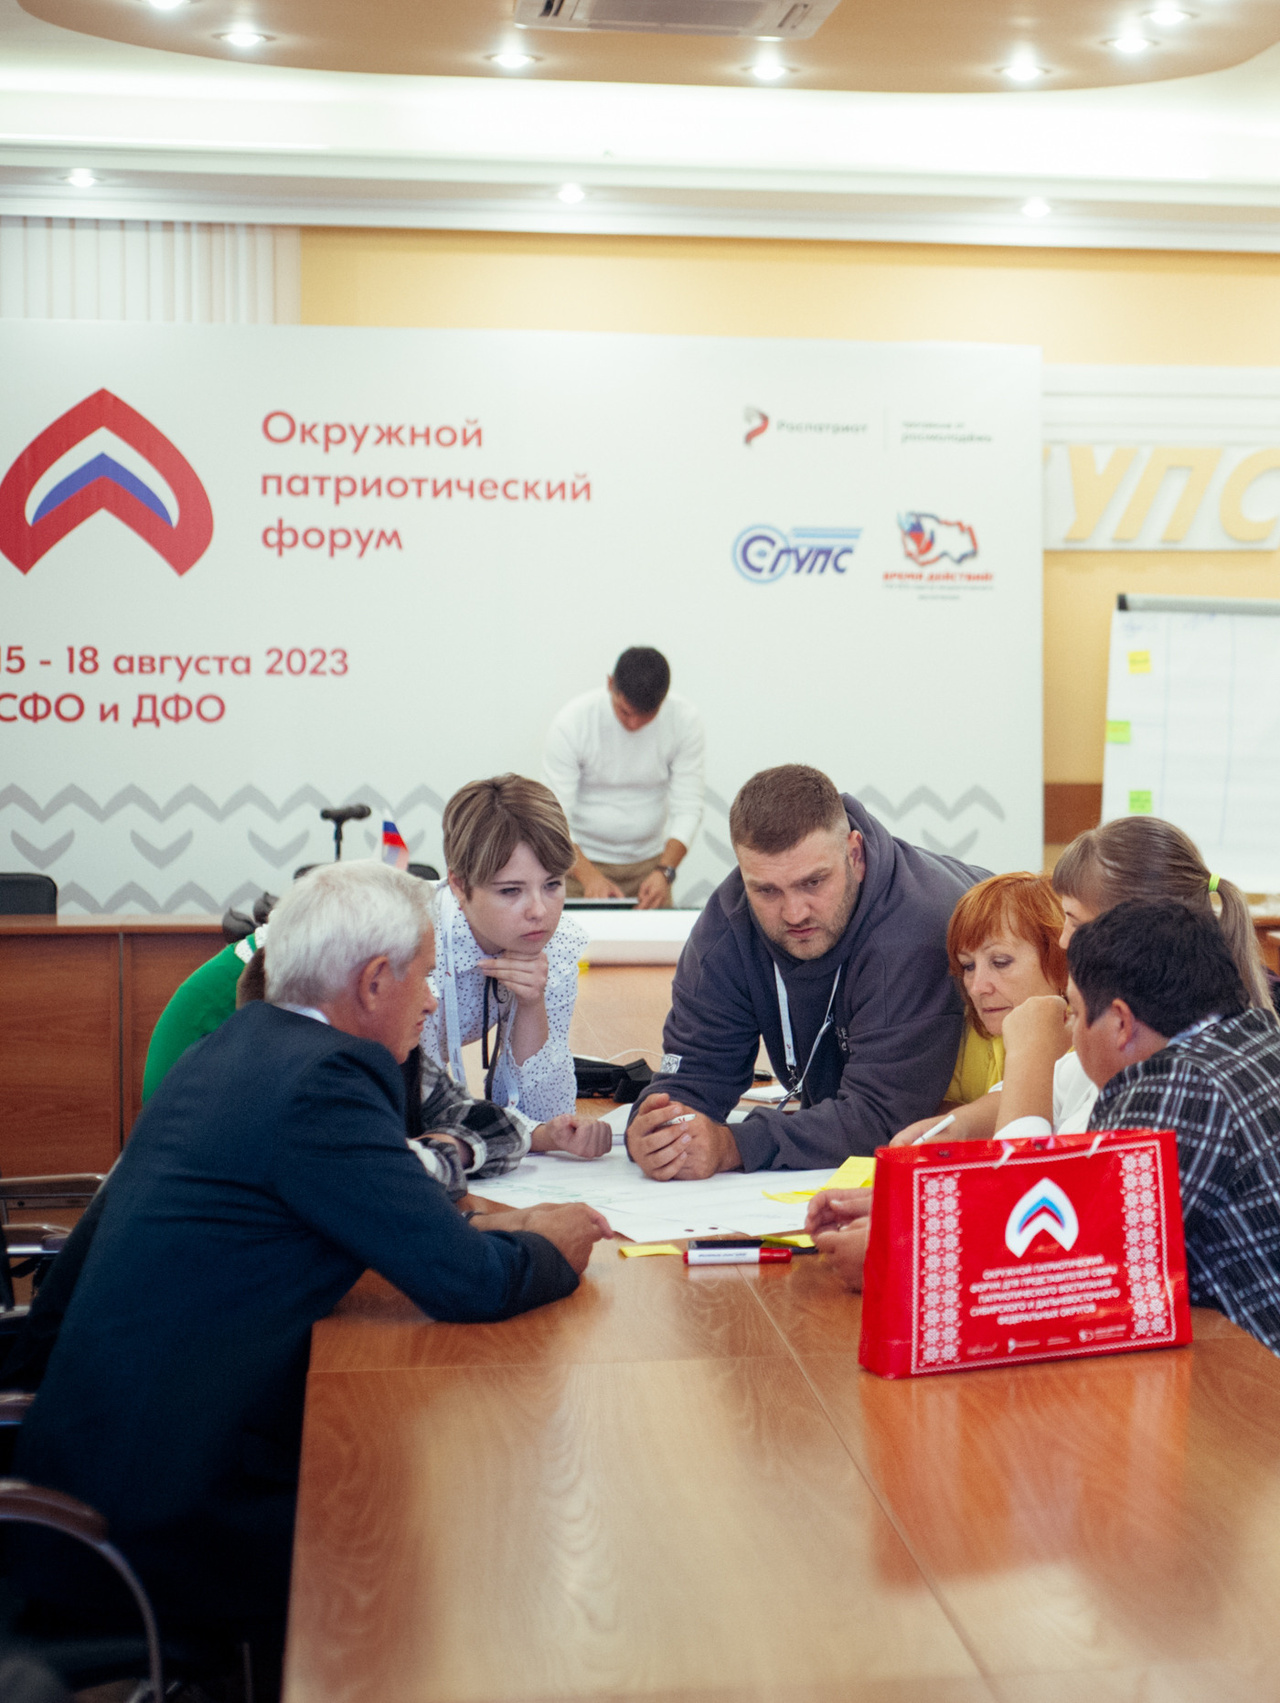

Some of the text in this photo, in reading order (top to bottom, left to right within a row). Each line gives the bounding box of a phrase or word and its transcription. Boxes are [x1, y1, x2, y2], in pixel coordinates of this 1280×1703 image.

[262, 411, 483, 454] Окружной
[262, 473, 591, 506] патриотический
[262, 518, 403, 558] форум
[0, 646, 26, 674] 5
[67, 646, 99, 674] 18
[113, 654, 251, 682] августа
[265, 647, 349, 675] 2023
[99, 703, 119, 722] и
[132, 693, 226, 728] ДФО
[983, 1265, 1032, 1280] ОКРУЖНОЙ
